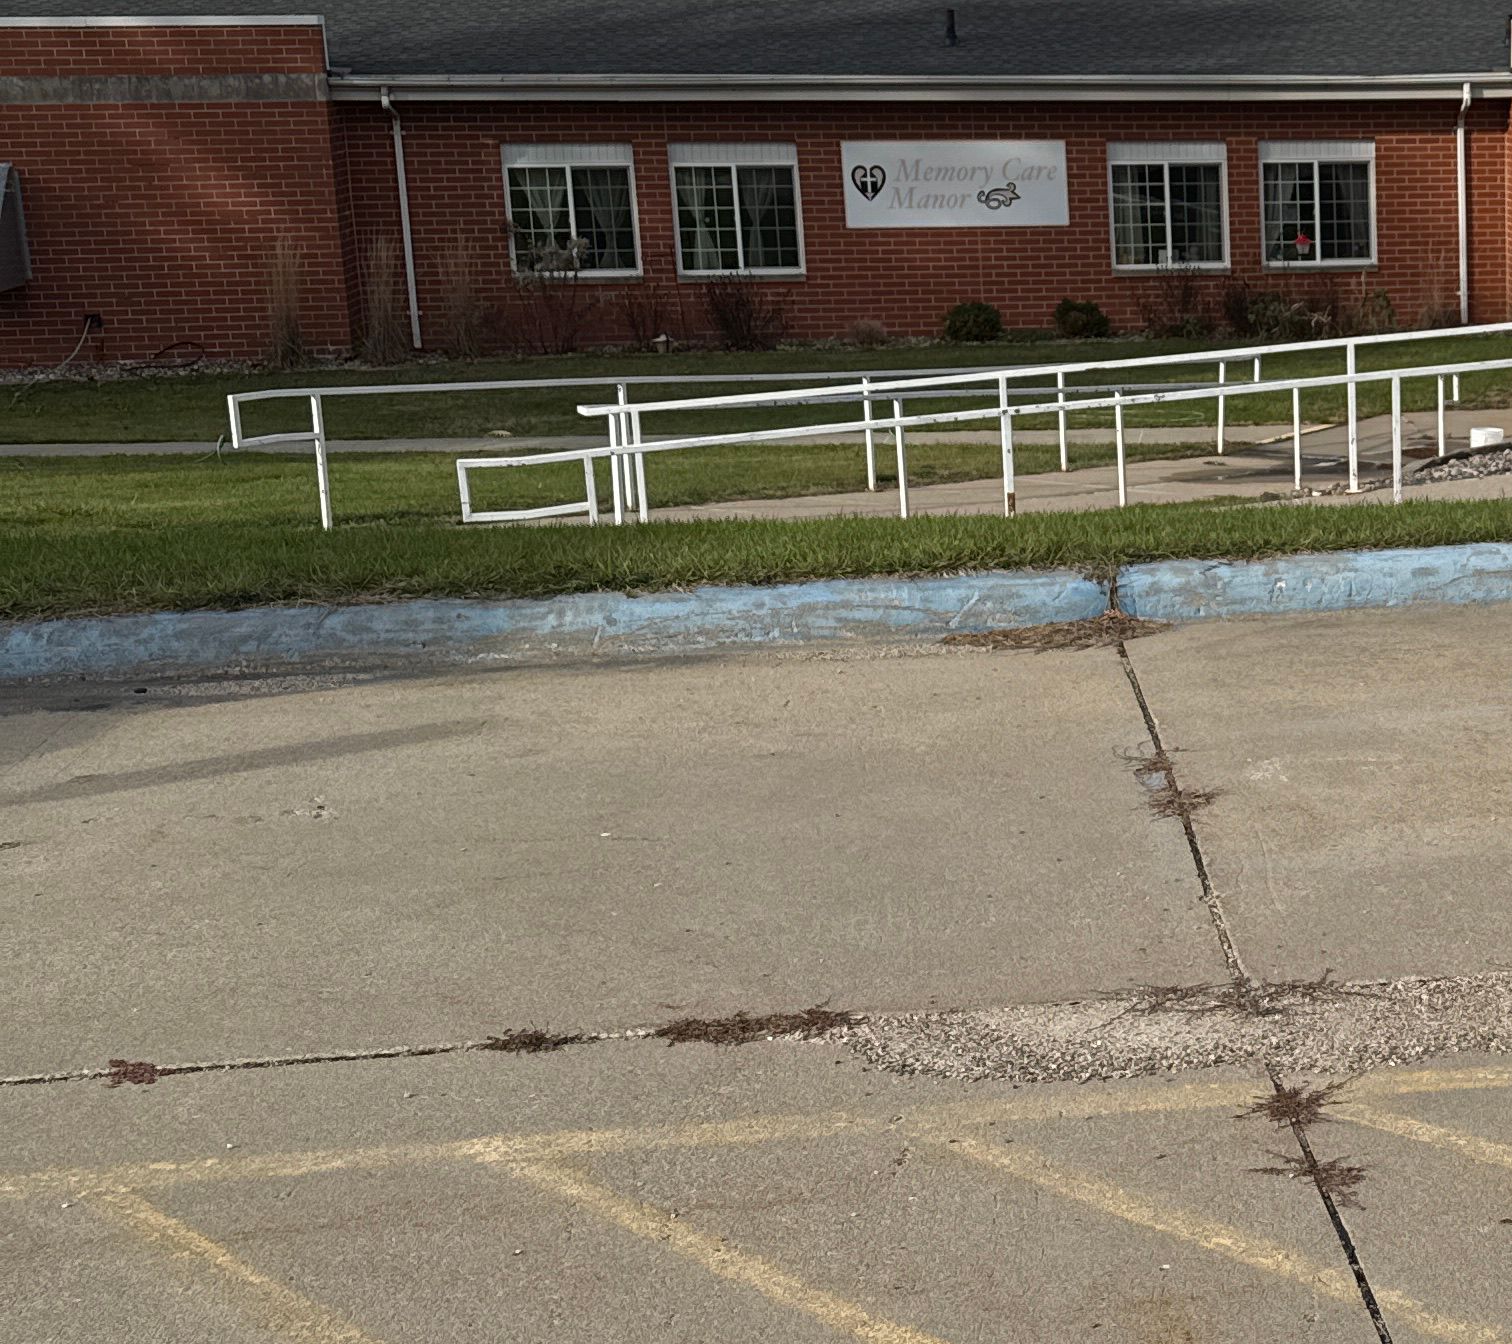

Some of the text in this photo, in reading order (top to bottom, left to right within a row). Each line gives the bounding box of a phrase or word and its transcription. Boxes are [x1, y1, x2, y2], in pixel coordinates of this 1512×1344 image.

[893, 157, 1058, 187] Memory Care
[888, 187, 972, 210] Manor
